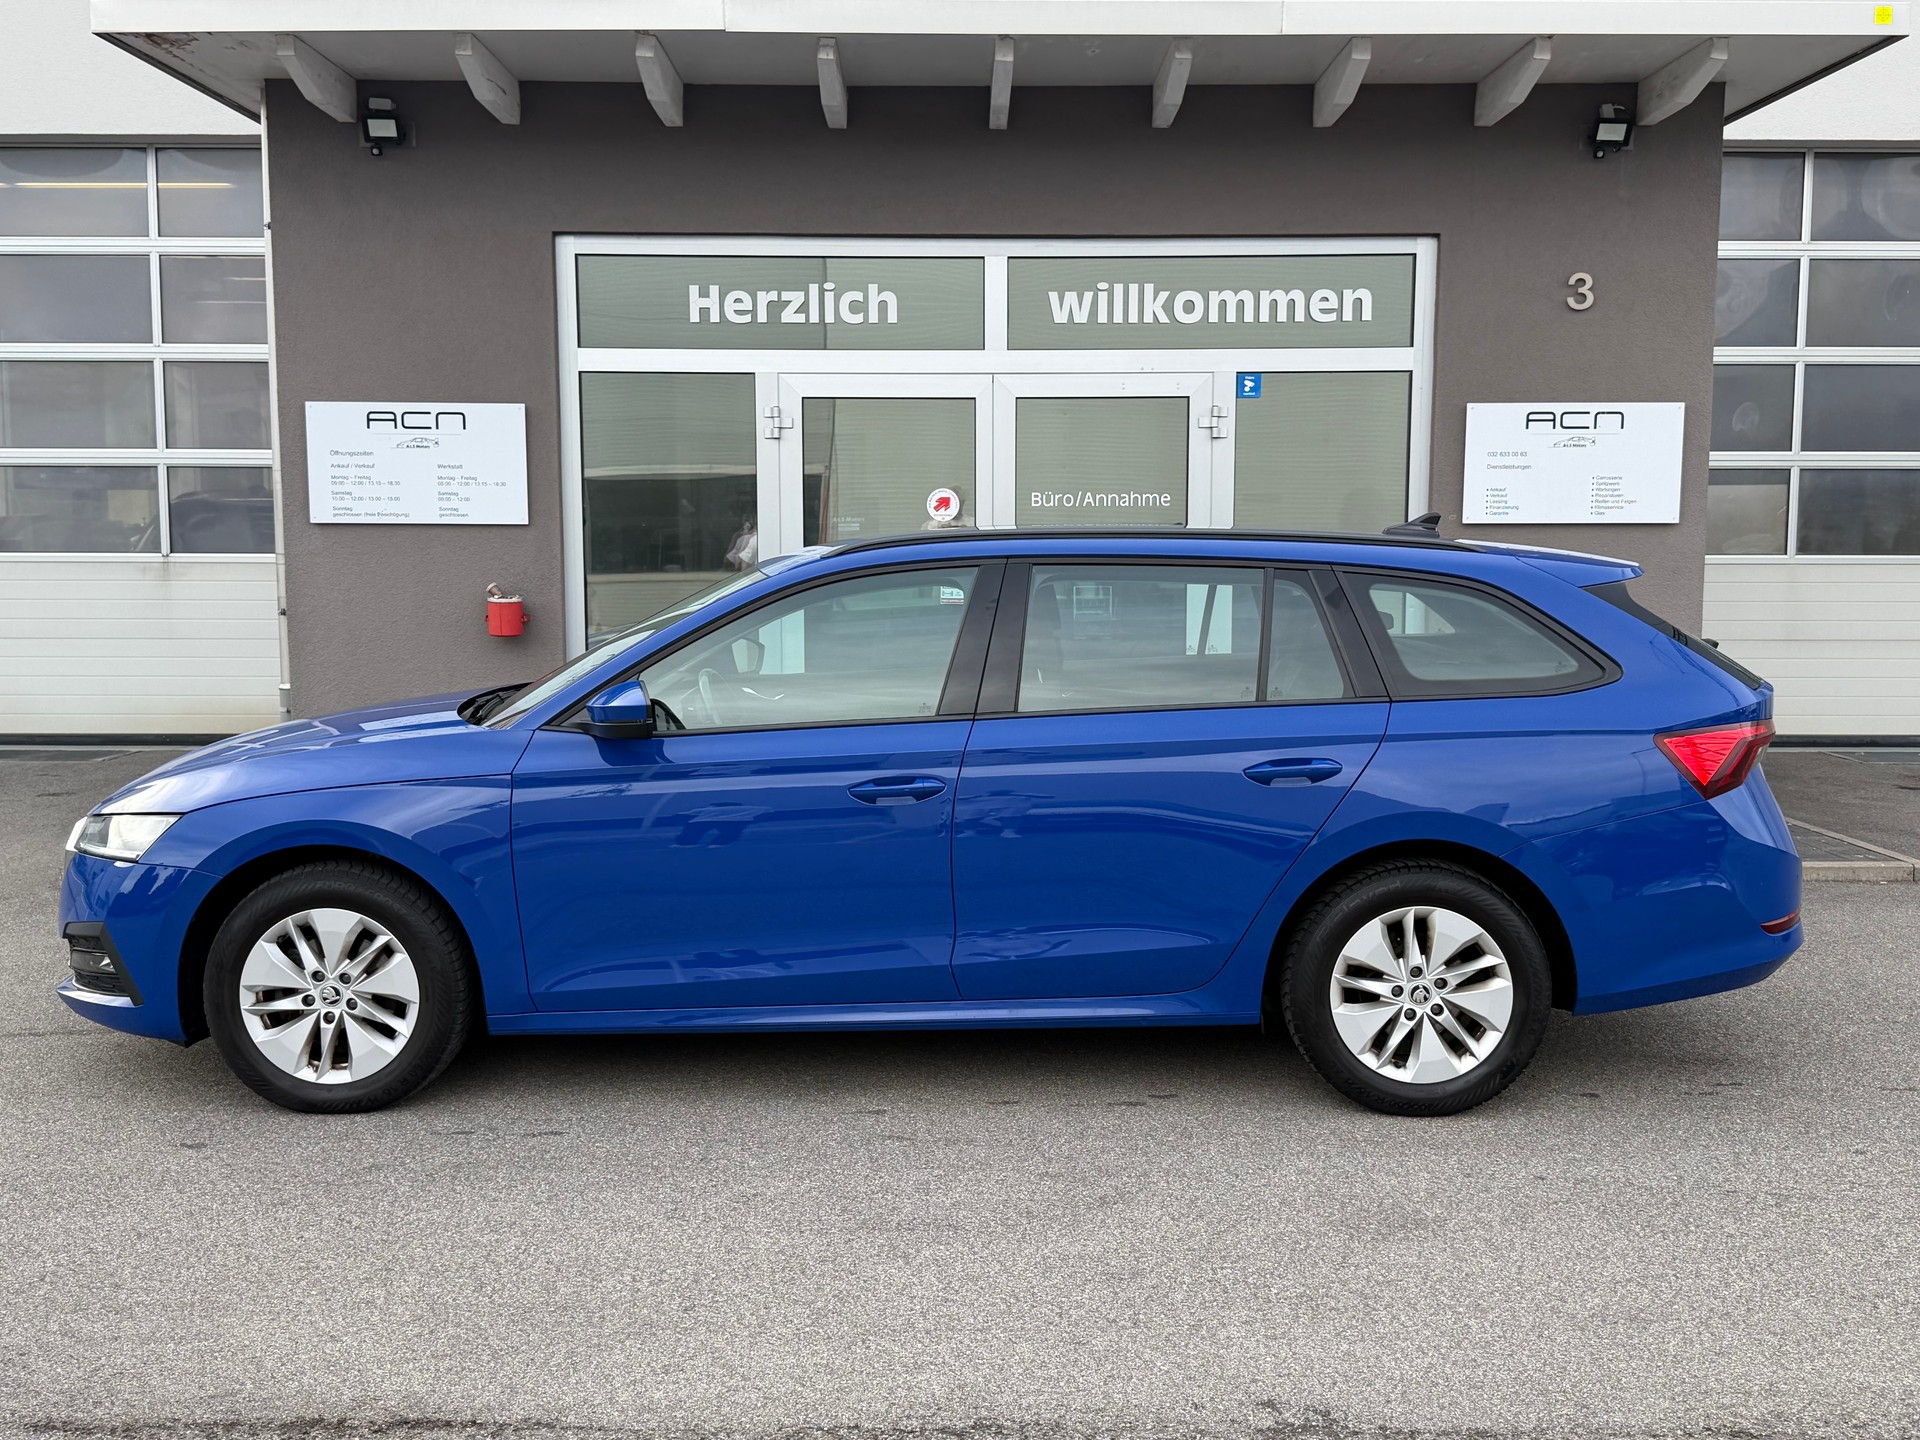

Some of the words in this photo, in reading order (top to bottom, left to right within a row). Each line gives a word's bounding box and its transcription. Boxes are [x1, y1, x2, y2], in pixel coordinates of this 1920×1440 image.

[688, 282, 898, 324] Herzlich
[1047, 281, 1373, 324] willkommen
[1566, 271, 1595, 311] 3
[329, 449, 374, 457] Öffnungszeiten
[1030, 491, 1171, 507] Büro/Annahme
